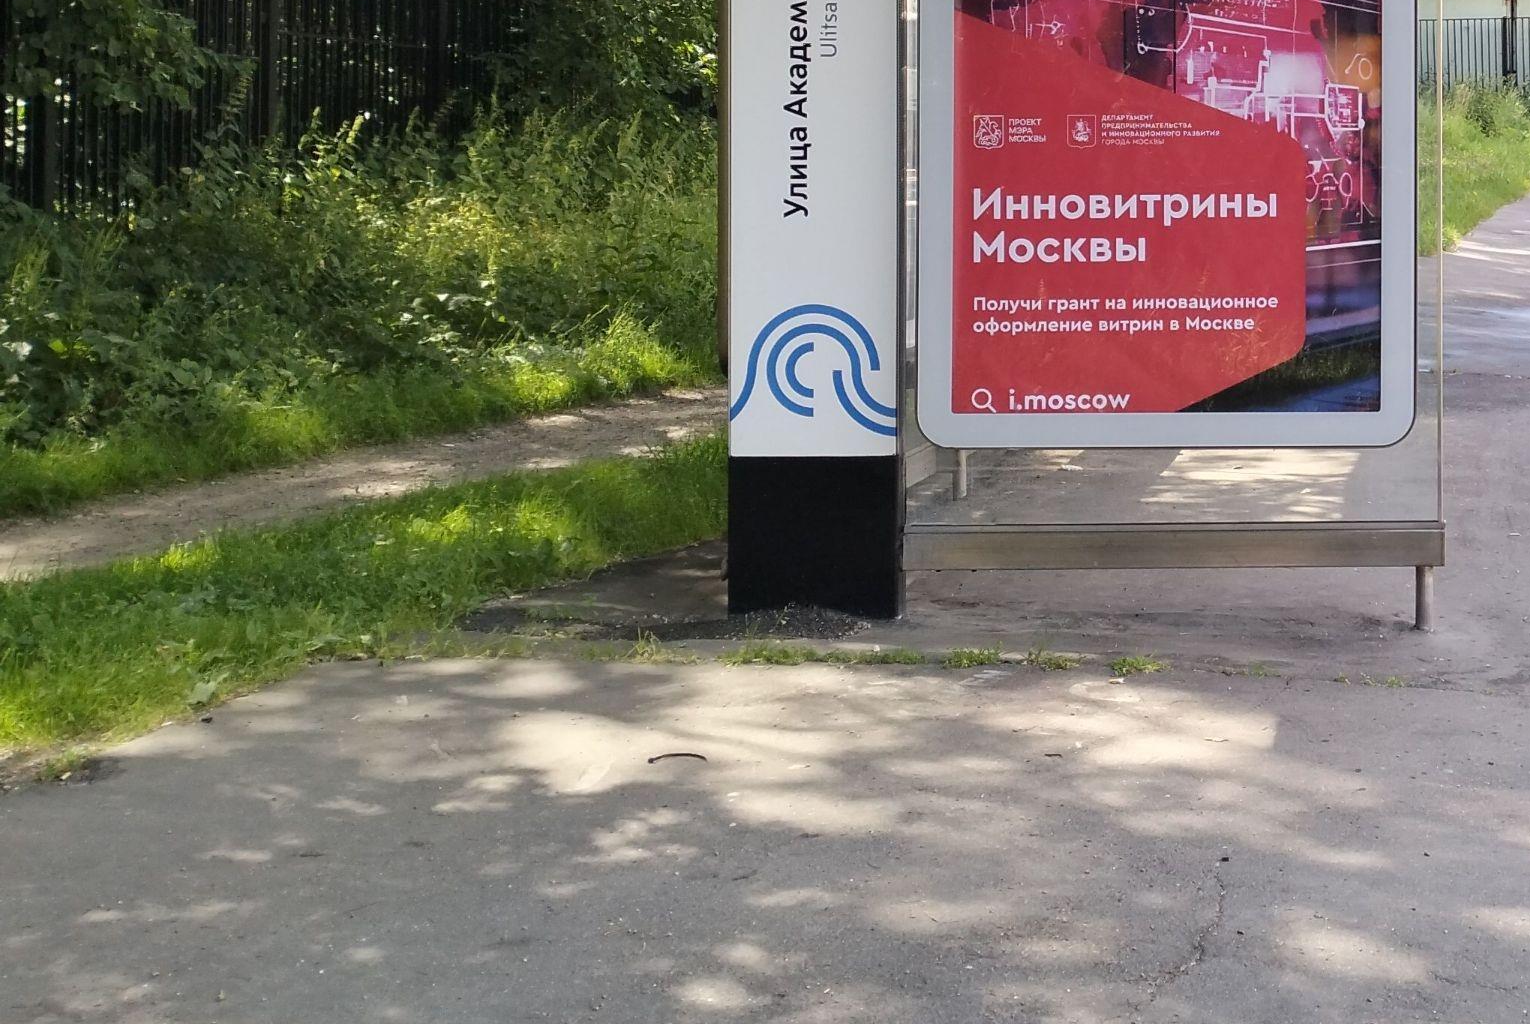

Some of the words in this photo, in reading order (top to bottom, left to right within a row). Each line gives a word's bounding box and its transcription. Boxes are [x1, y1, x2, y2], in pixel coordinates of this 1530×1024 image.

[819, 2, 838, 58] Ulitsa
[1008, 118, 1042, 126] ПРОЕКТ
[1101, 114, 1154, 122] ДЕПАРТАМЕНТ
[1008, 126, 1033, 134] МЭРА
[1101, 122, 1193, 130] ПРЕДПРИНИМАТЕЛЬСТВА
[1008, 134, 1047, 143] МОСКВЫ
[1108, 130, 1181, 138] ИННОВАЦИОННОГО
[1101, 138, 1131, 146] ГОРОДА
[783, 127, 812, 218] Улица
[973, 187, 1277, 227] Инновитрины
[973, 231, 1146, 263] Москвы
[973, 296, 1042, 314] Получи
[1048, 297, 1100, 314] грант
[1105, 298, 1127, 310] на
[1132, 296, 1279, 312] инновационное
[972, 316, 1093, 336] оформление
[1098, 318, 1164, 335] витрин
[1169, 319, 1180, 331] в
[1185, 316, 1255, 331] Москве
[1009, 388, 1131, 411] i.moscow
